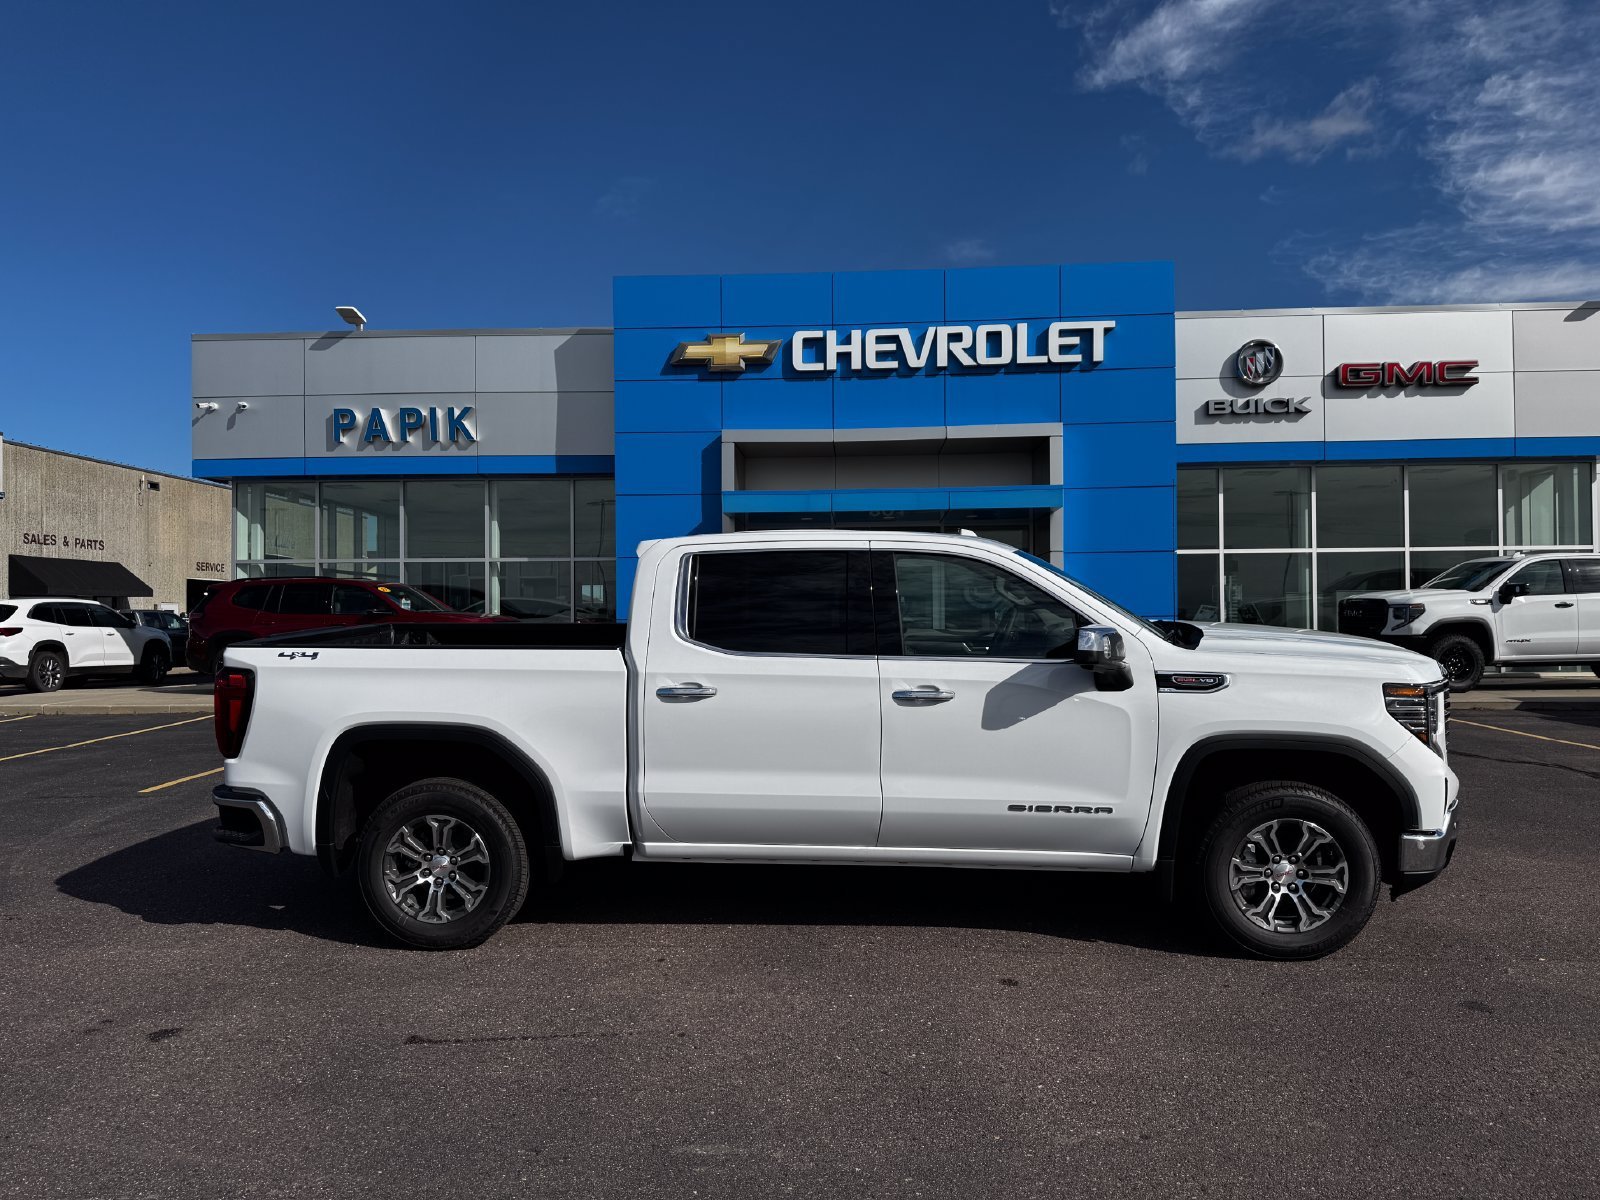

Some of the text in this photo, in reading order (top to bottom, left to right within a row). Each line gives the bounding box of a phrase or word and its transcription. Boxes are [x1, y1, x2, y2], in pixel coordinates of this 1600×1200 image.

[792, 320, 1116, 371] CHEVROLET
[1338, 360, 1479, 387] GMC
[1208, 396, 1312, 415] BUICK
[333, 401, 476, 443] PAPIK
[23, 533, 105, 551] SALES & PARTS
[196, 561, 225, 573] SERVICE
[1007, 804, 1114, 815] SIERRA
